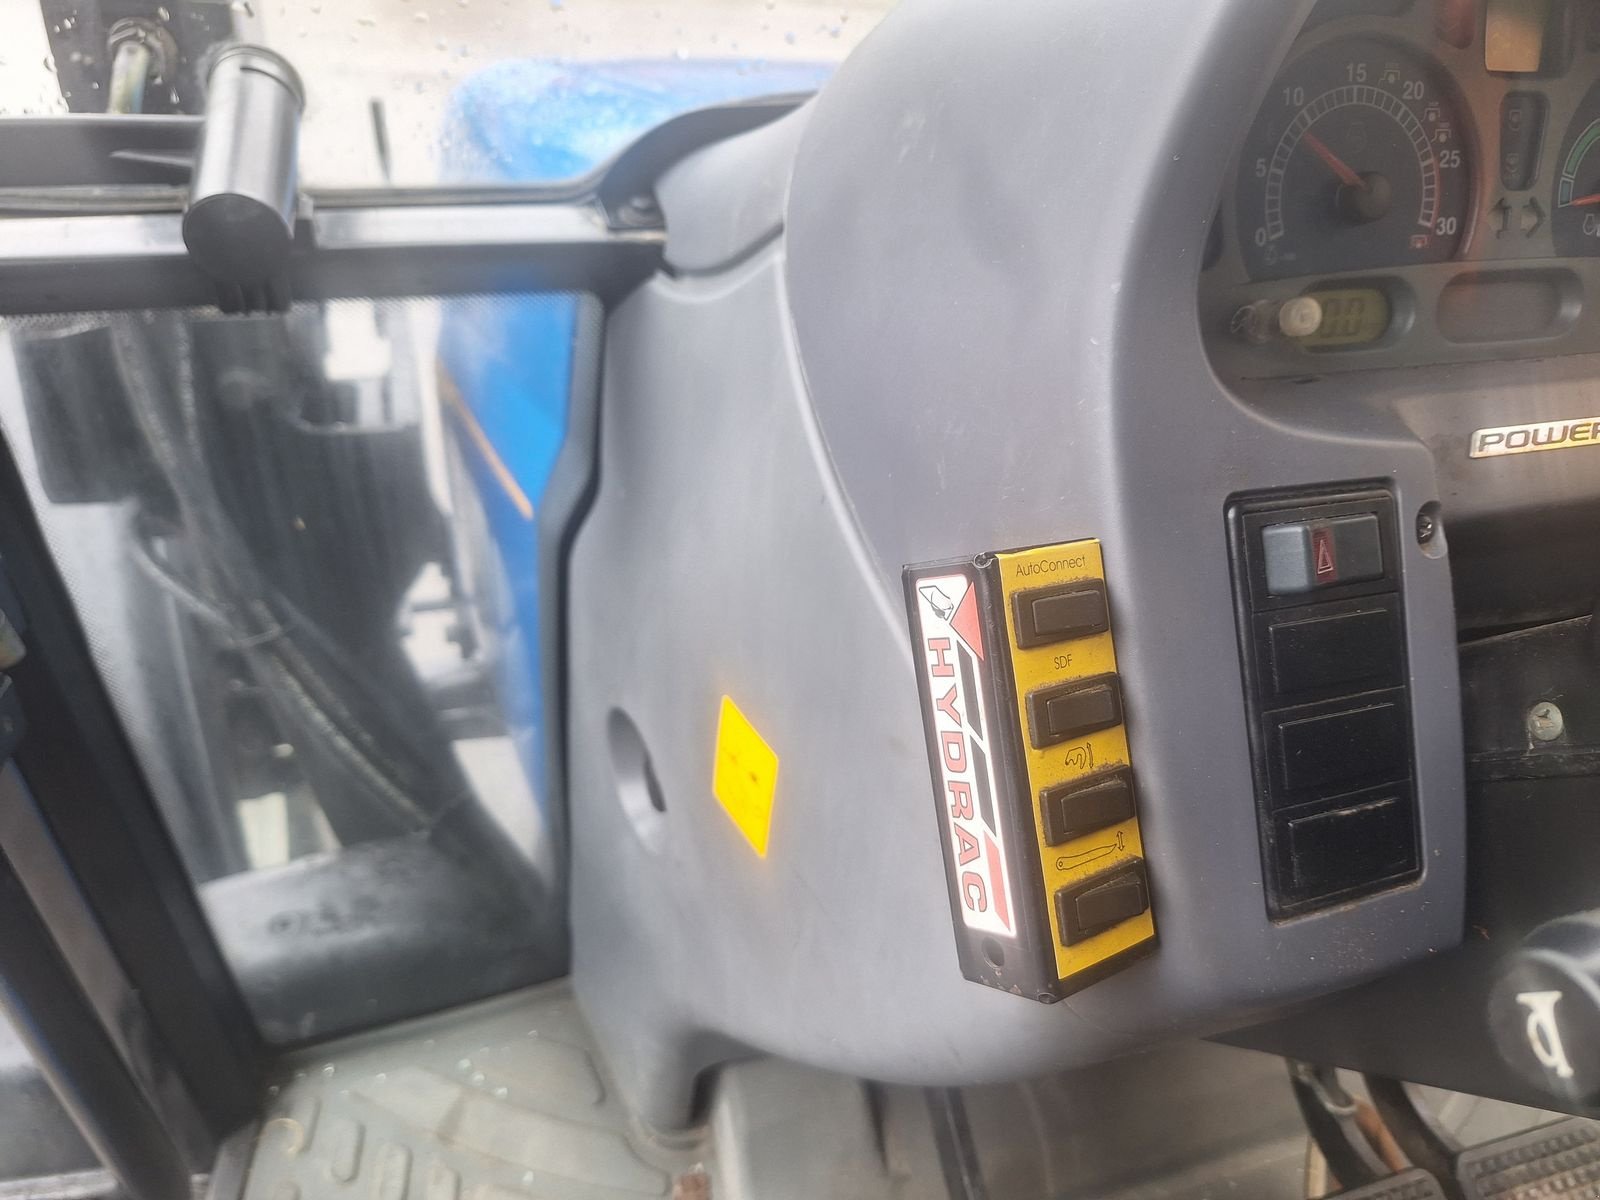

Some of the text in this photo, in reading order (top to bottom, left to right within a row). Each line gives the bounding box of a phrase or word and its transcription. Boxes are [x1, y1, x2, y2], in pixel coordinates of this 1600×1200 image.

[1345, 63, 1367, 83] 15
[1283, 87, 1305, 107] 10
[1402, 81, 1425, 100] 20
[1255, 158, 1267, 177] 5
[1439, 150, 1461, 170] 25
[1436, 217, 1457, 236] 30
[1255, 227, 1266, 247] 0
[1015, 555, 1086, 578] AutoConnect
[1053, 653, 1074, 670] SDF
[927, 636, 988, 913] HYDRAC
